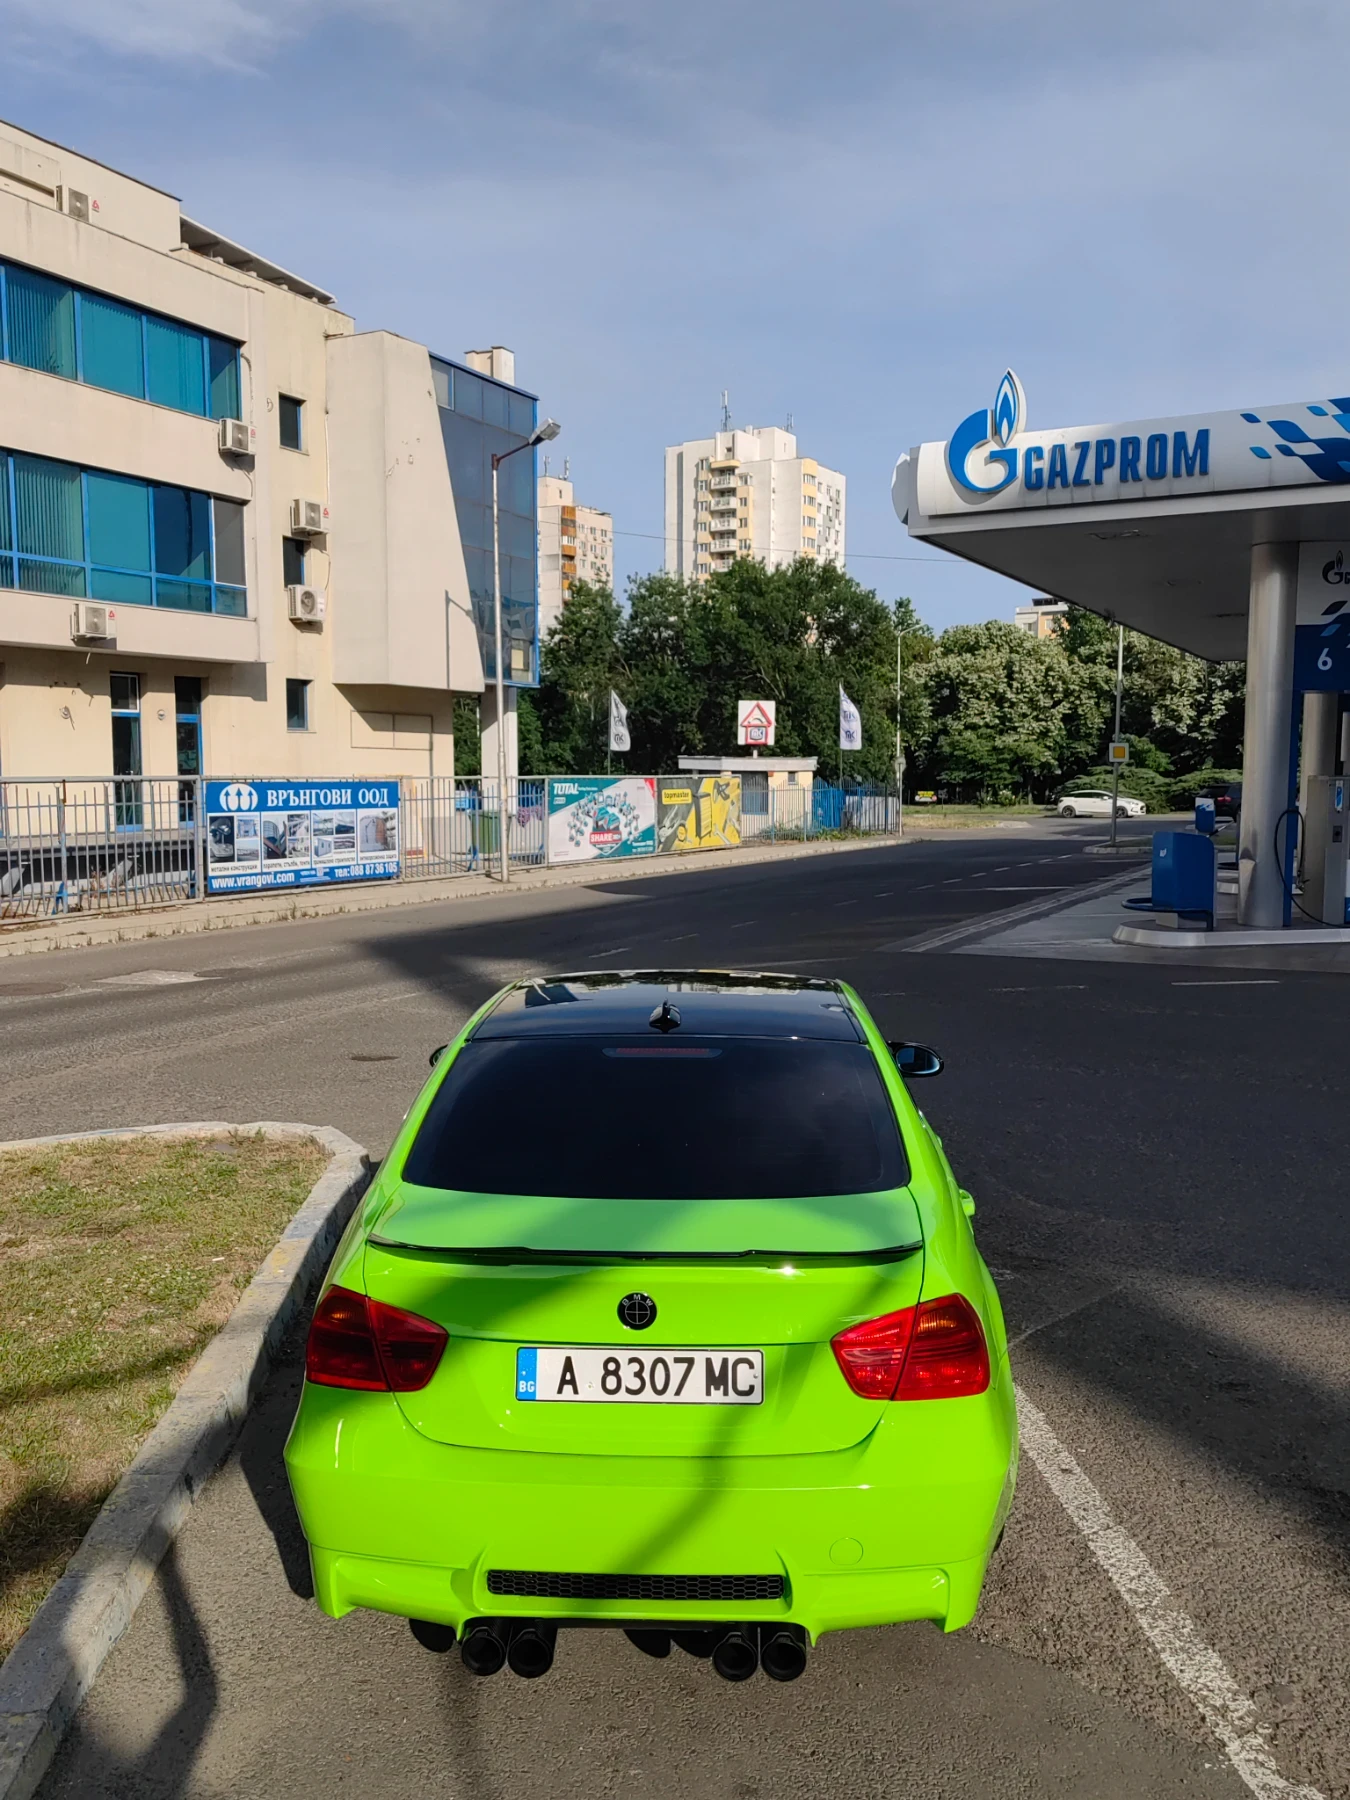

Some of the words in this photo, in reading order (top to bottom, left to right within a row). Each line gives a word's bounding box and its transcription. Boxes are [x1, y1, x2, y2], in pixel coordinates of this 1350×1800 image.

[1024, 428, 1211, 491] GAZPROM
[1317, 647, 1333, 671] 6
[553, 782, 579, 795] TOTAL
[664, 791, 690, 800] topmaster
[266, 788, 352, 807] ВРЪНГОВИ
[358, 788, 389, 807] ООД
[590, 833, 613, 843] SHARE
[211, 872, 295, 888] www.vrangovi.com
[334, 867, 350, 878] тел:
[518, 1381, 535, 1393] BG
[556, 1355, 579, 1395] A
[601, 1356, 696, 1396] 8307
[705, 1357, 756, 1397] MC
